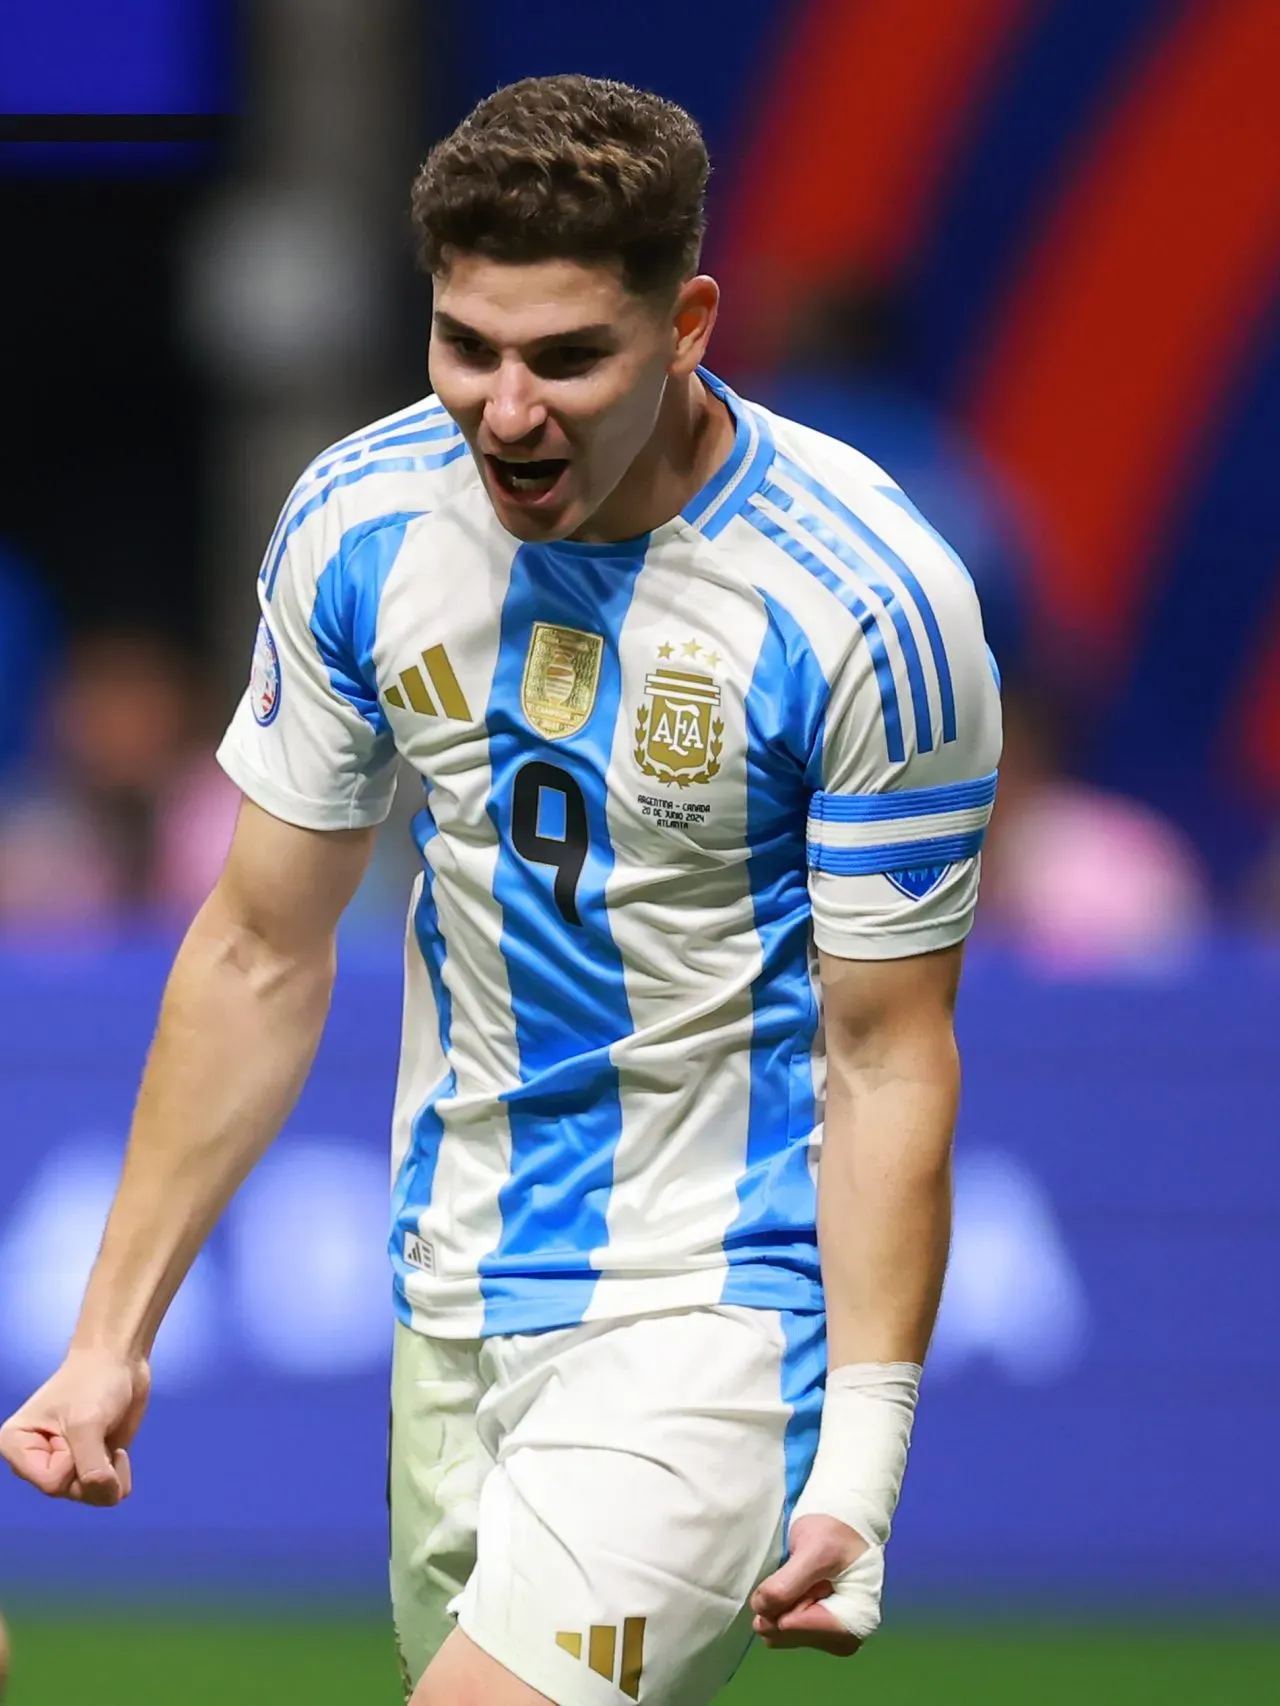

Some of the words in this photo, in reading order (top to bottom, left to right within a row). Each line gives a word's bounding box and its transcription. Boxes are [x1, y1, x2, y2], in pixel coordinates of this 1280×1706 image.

[651, 698, 704, 757] AFA
[637, 794, 674, 810] ARGENTINA
[682, 802, 712, 813] CANADA
[641, 805, 651, 815] 20
[653, 808, 662, 817] DE
[665, 811, 684, 820] JUNIO
[685, 813, 705, 823] 2024
[656, 819, 689, 830] ATLANTA
[511, 761, 589, 927] 9
